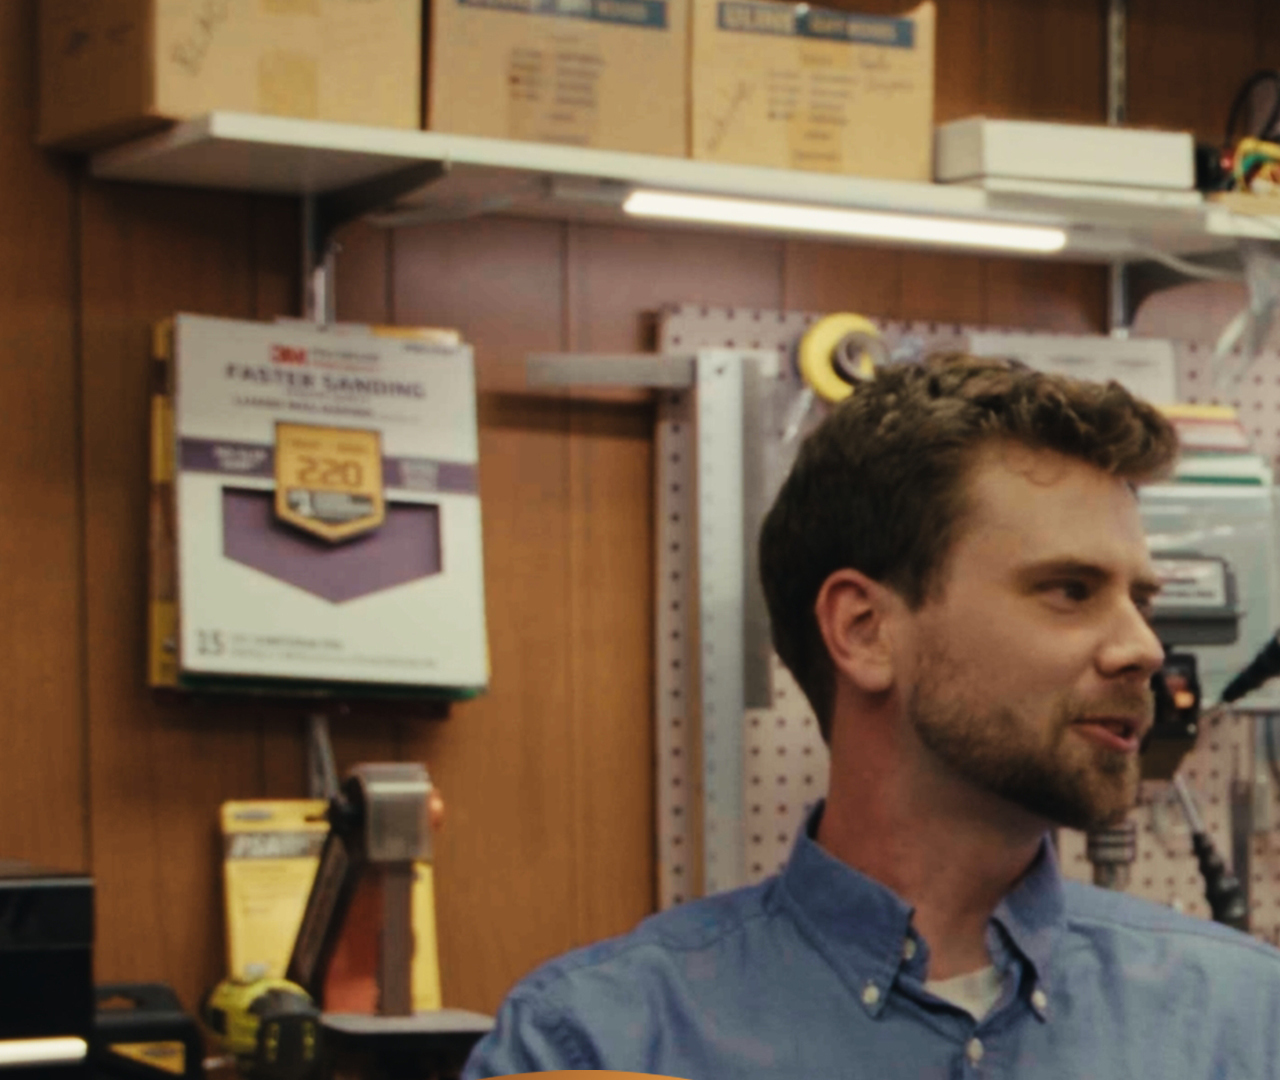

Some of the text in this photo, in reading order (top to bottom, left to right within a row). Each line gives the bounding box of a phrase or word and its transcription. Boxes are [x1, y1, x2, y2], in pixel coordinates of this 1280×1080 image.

[271, 344, 307, 366] 3M
[225, 363, 425, 398] FASTER SANDING
[297, 455, 364, 488] 220
